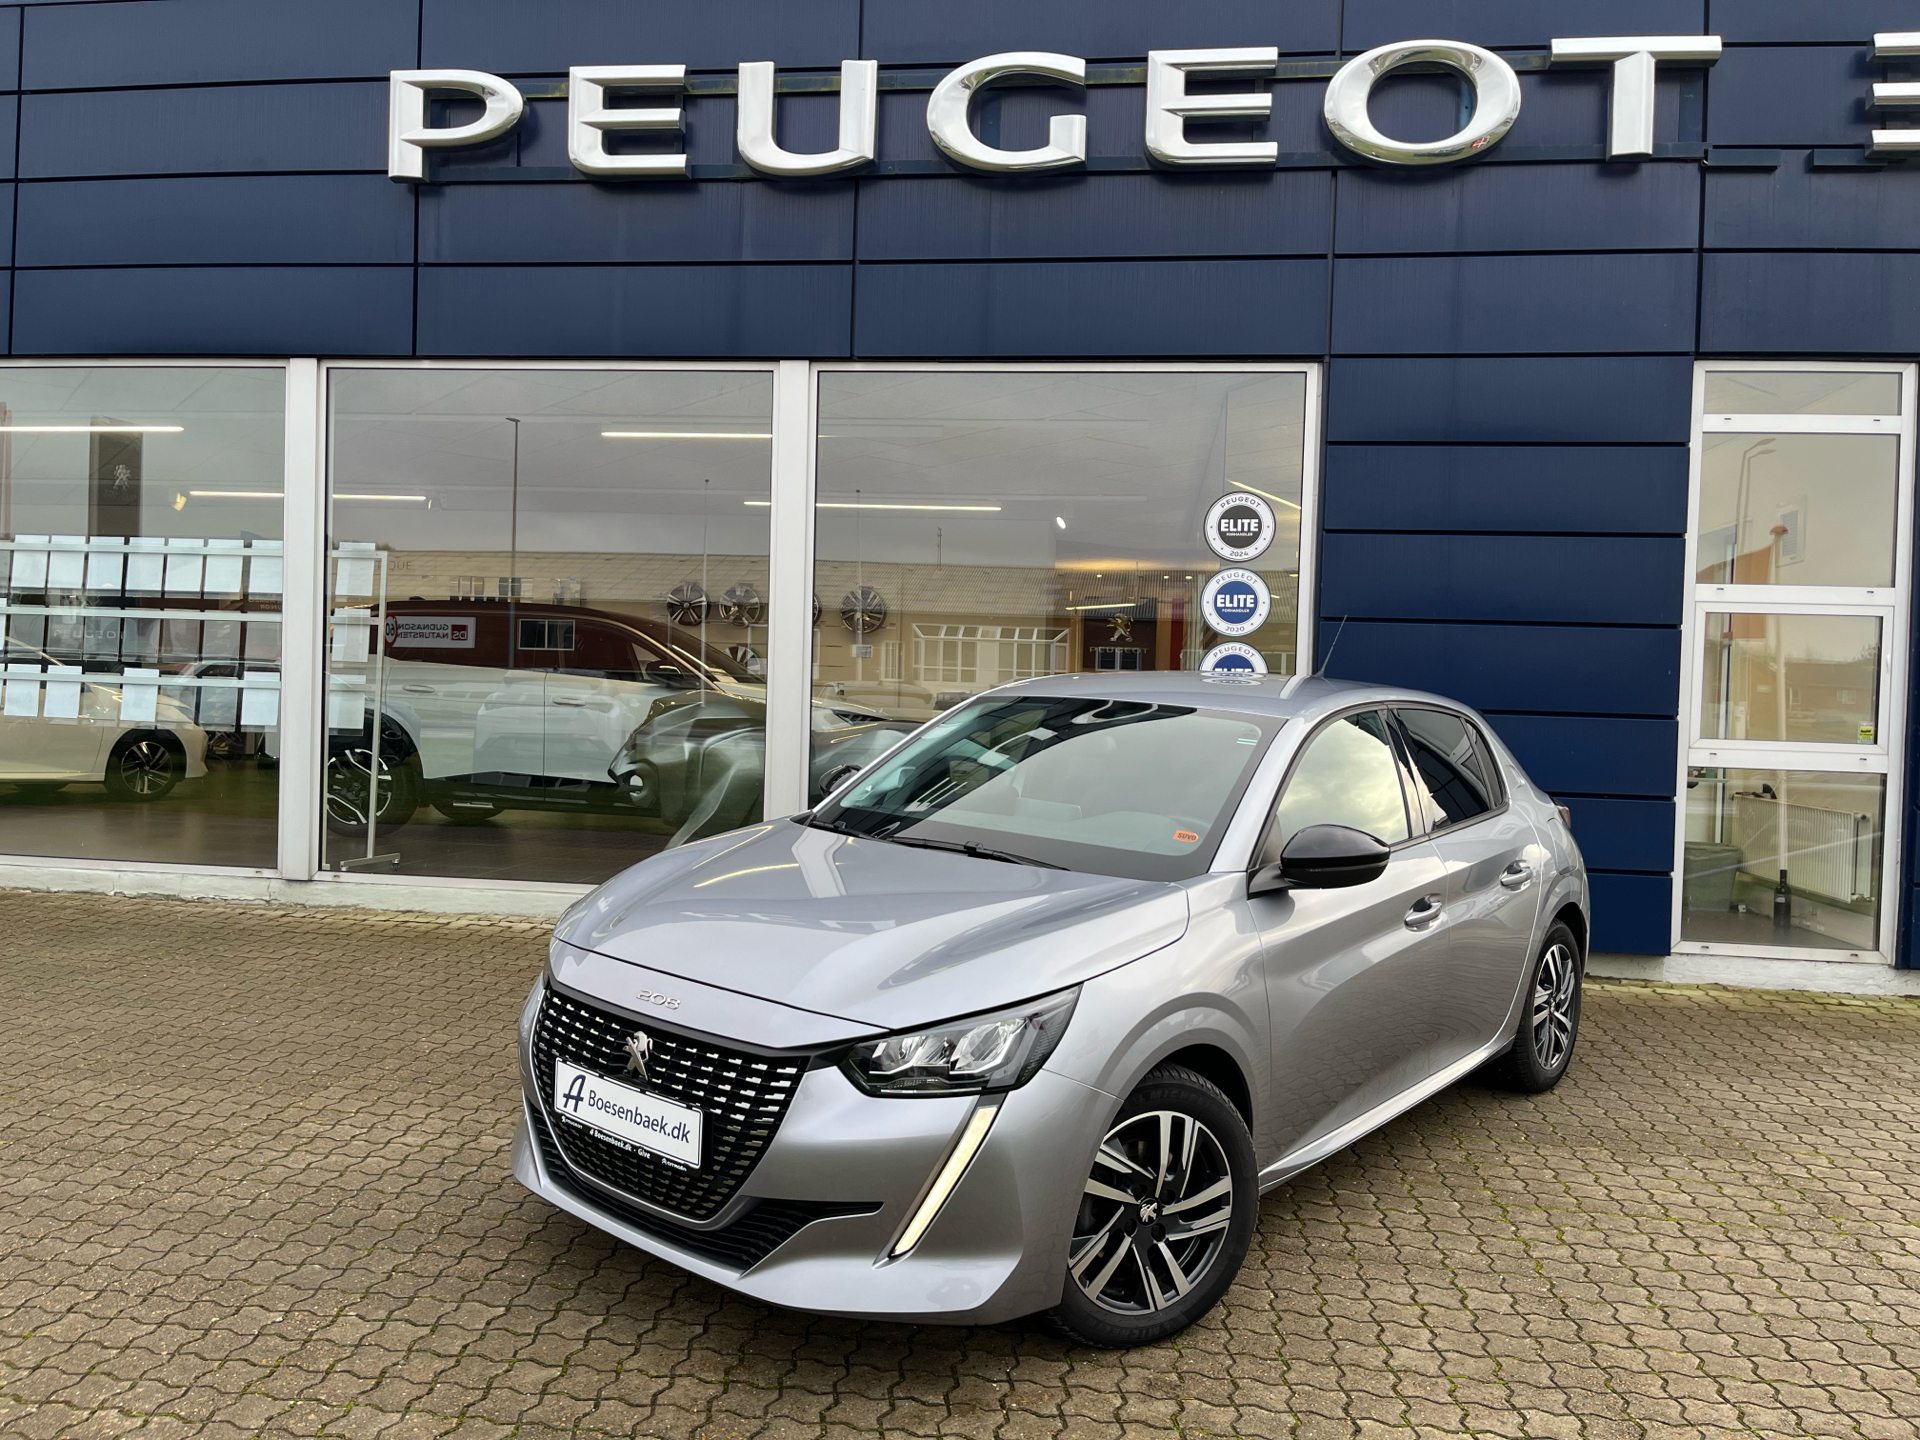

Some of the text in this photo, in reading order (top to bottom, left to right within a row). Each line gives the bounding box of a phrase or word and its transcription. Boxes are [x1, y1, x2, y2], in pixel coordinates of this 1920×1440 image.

[388, 36, 1723, 182] PEUGEOT
[1220, 496, 1261, 508] PEUGEOT
[1221, 519, 1258, 531] ELITE
[1216, 572, 1258, 585] PEUGEOT
[1216, 594, 1255, 608] ELITE
[1089, 646, 1149, 654] PEUGEOT
[1213, 645, 1256, 658] PEUGEOT
[636, 989, 681, 1010] 208
[587, 1089, 691, 1144] Boesenbaek.dk
[594, 1130, 632, 1152] Boesenbaek.dk
[638, 1148, 651, 1159] Give
